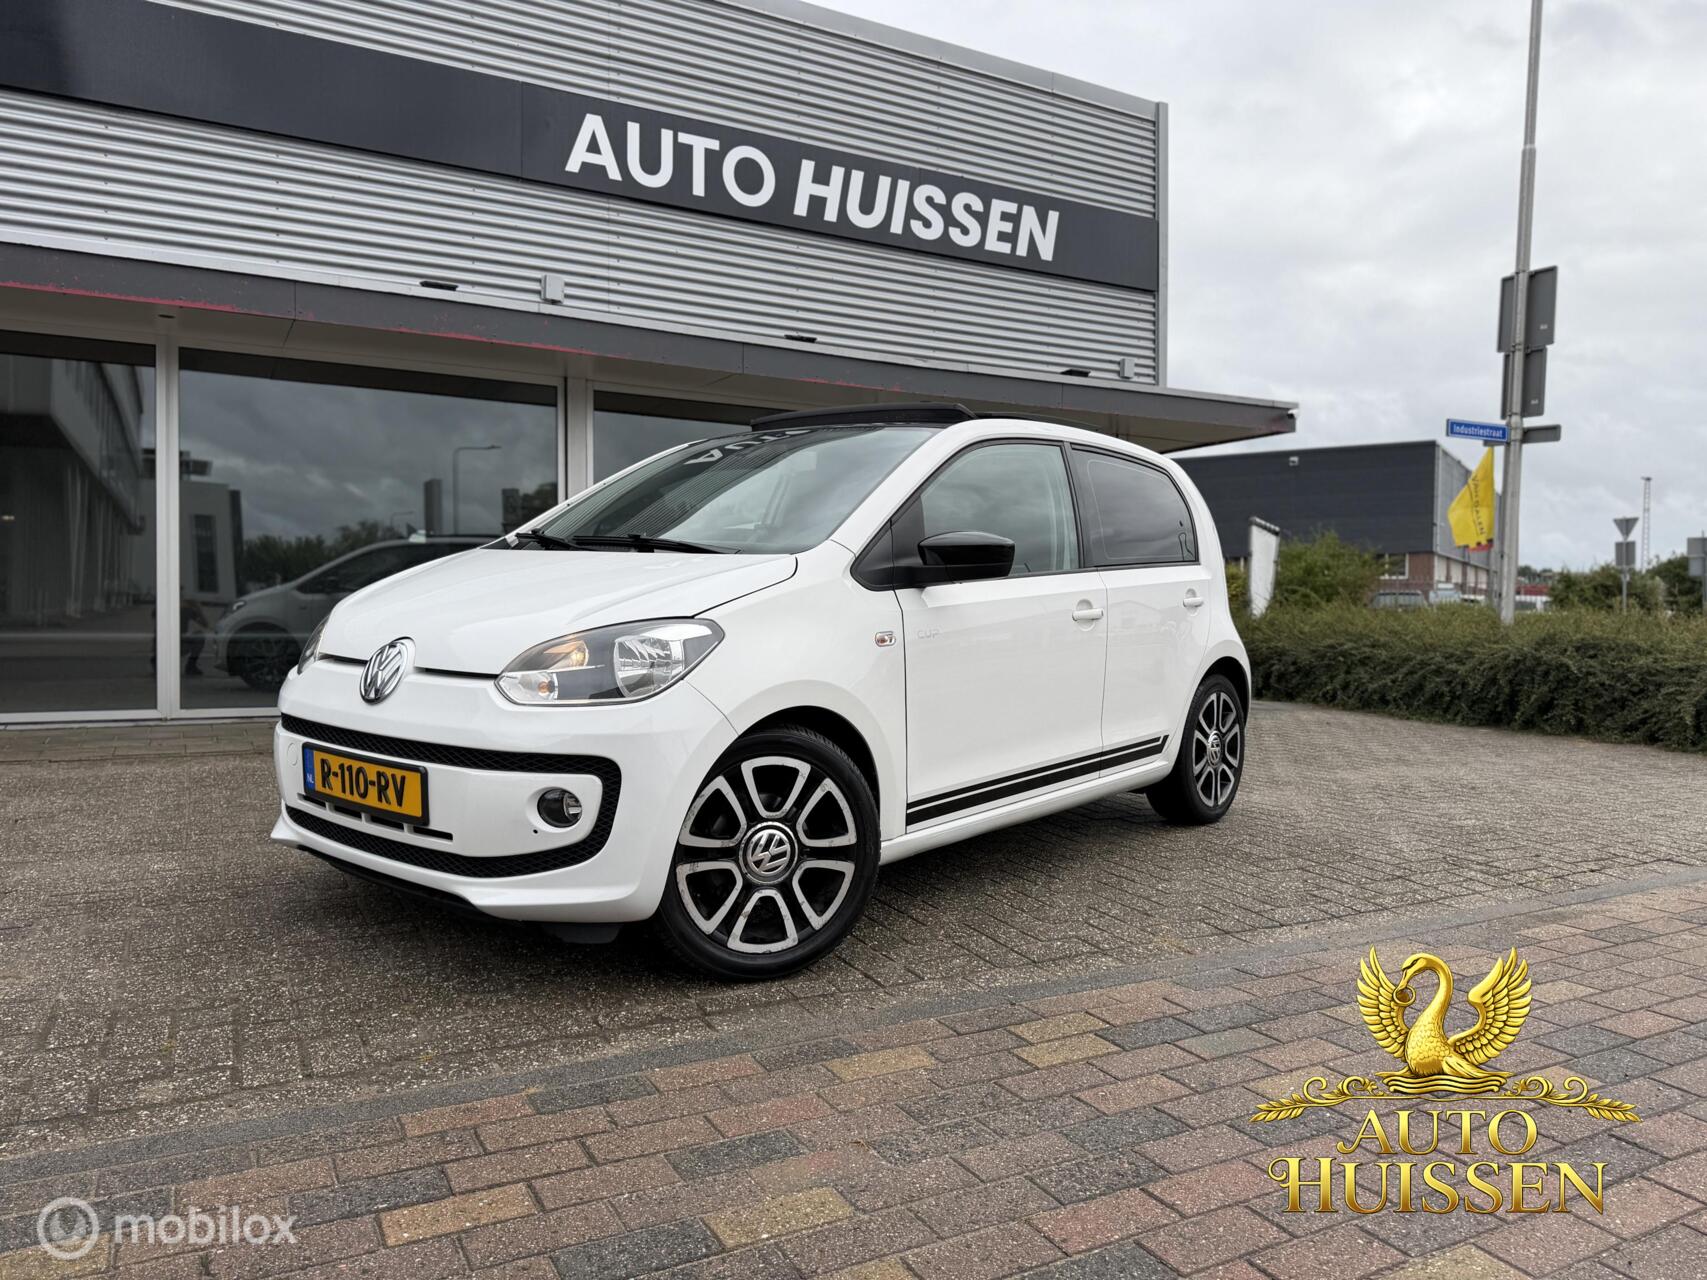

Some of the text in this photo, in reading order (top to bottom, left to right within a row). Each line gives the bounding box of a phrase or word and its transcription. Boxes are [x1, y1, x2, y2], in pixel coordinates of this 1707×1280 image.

[564, 112, 1060, 261] AUTO HUISSEN
[1453, 423, 1503, 438] Industriestraat
[917, 628, 941, 639] CUP
[306, 774, 315, 784] NL
[320, 758, 406, 807] R-110-RV
